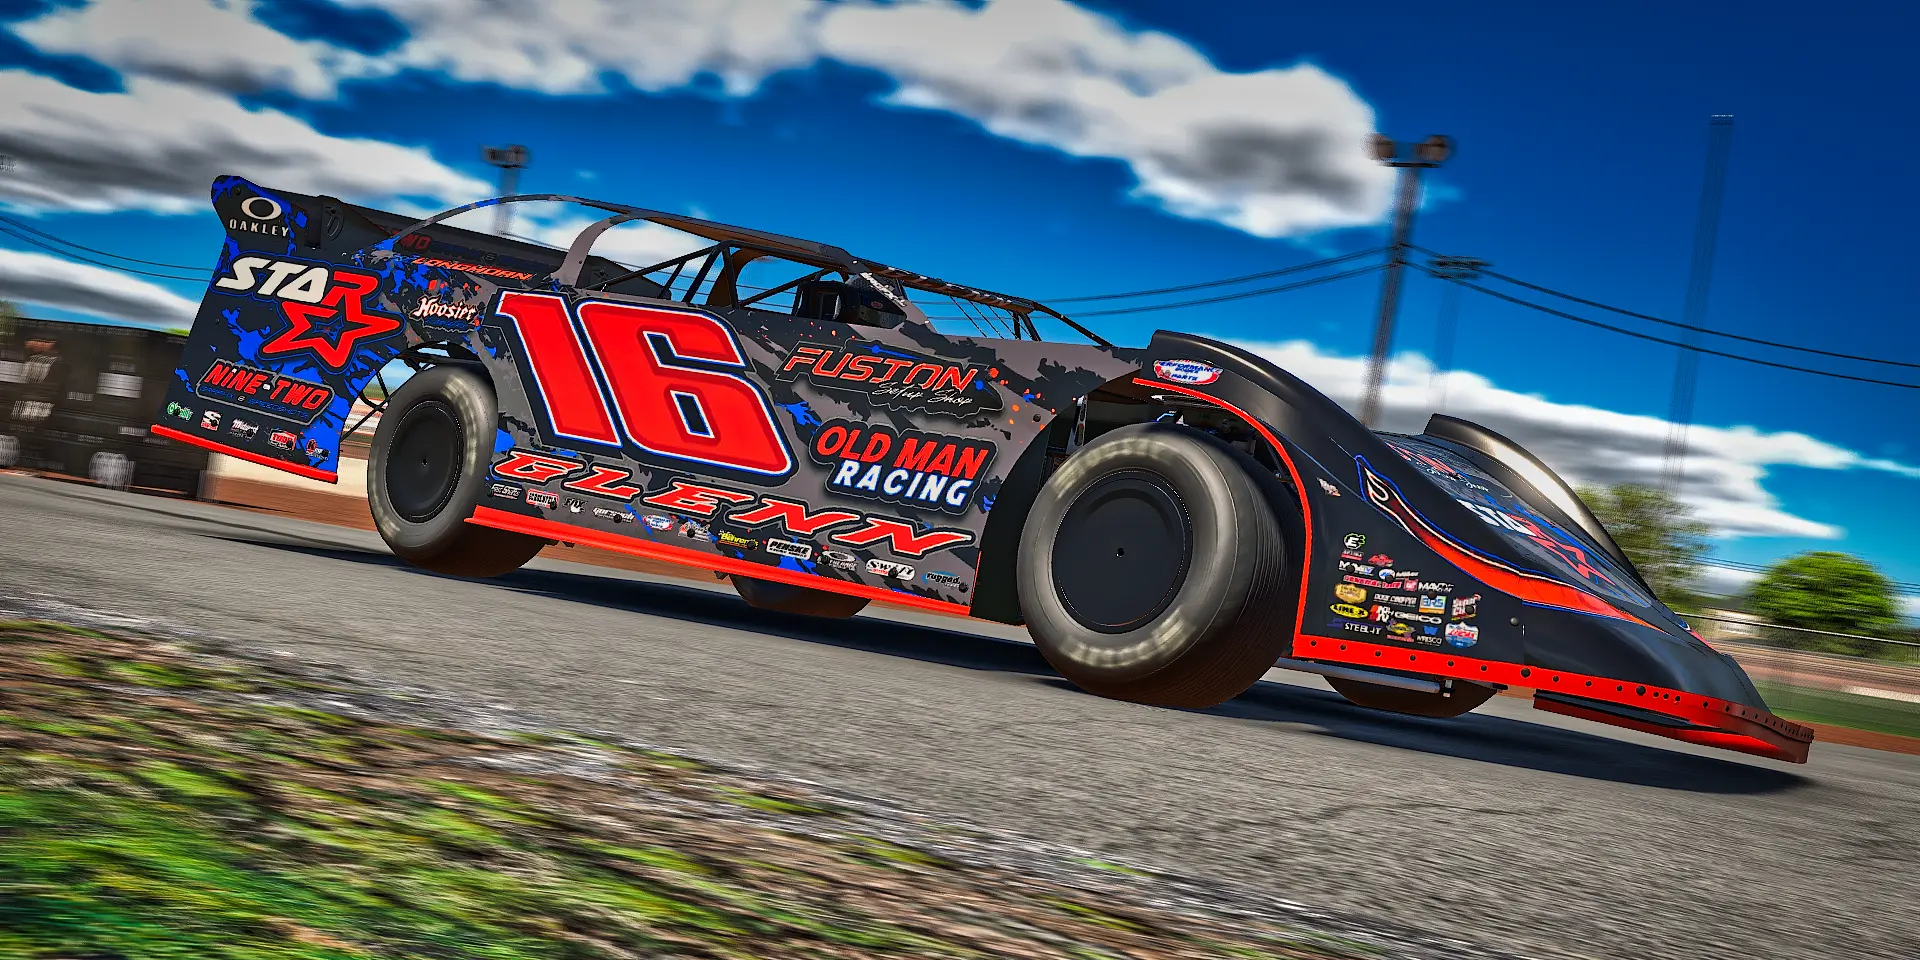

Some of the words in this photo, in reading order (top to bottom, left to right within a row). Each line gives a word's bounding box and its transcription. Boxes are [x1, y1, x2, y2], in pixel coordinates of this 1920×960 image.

[229, 218, 289, 237] OAKLEY
[215, 256, 379, 308] STAR
[411, 257, 534, 281] LONGHORN
[412, 296, 477, 321] Hoosier
[495, 290, 792, 475] 16
[784, 347, 978, 392] FUSION
[872, 381, 924, 399] Setup
[928, 390, 973, 405] Shop
[816, 426, 892, 463] OLD
[893, 437, 989, 479] MAN
[494, 450, 973, 556] GLENN
[833, 460, 973, 506] RACING
[770, 540, 810, 554] PENSKE
